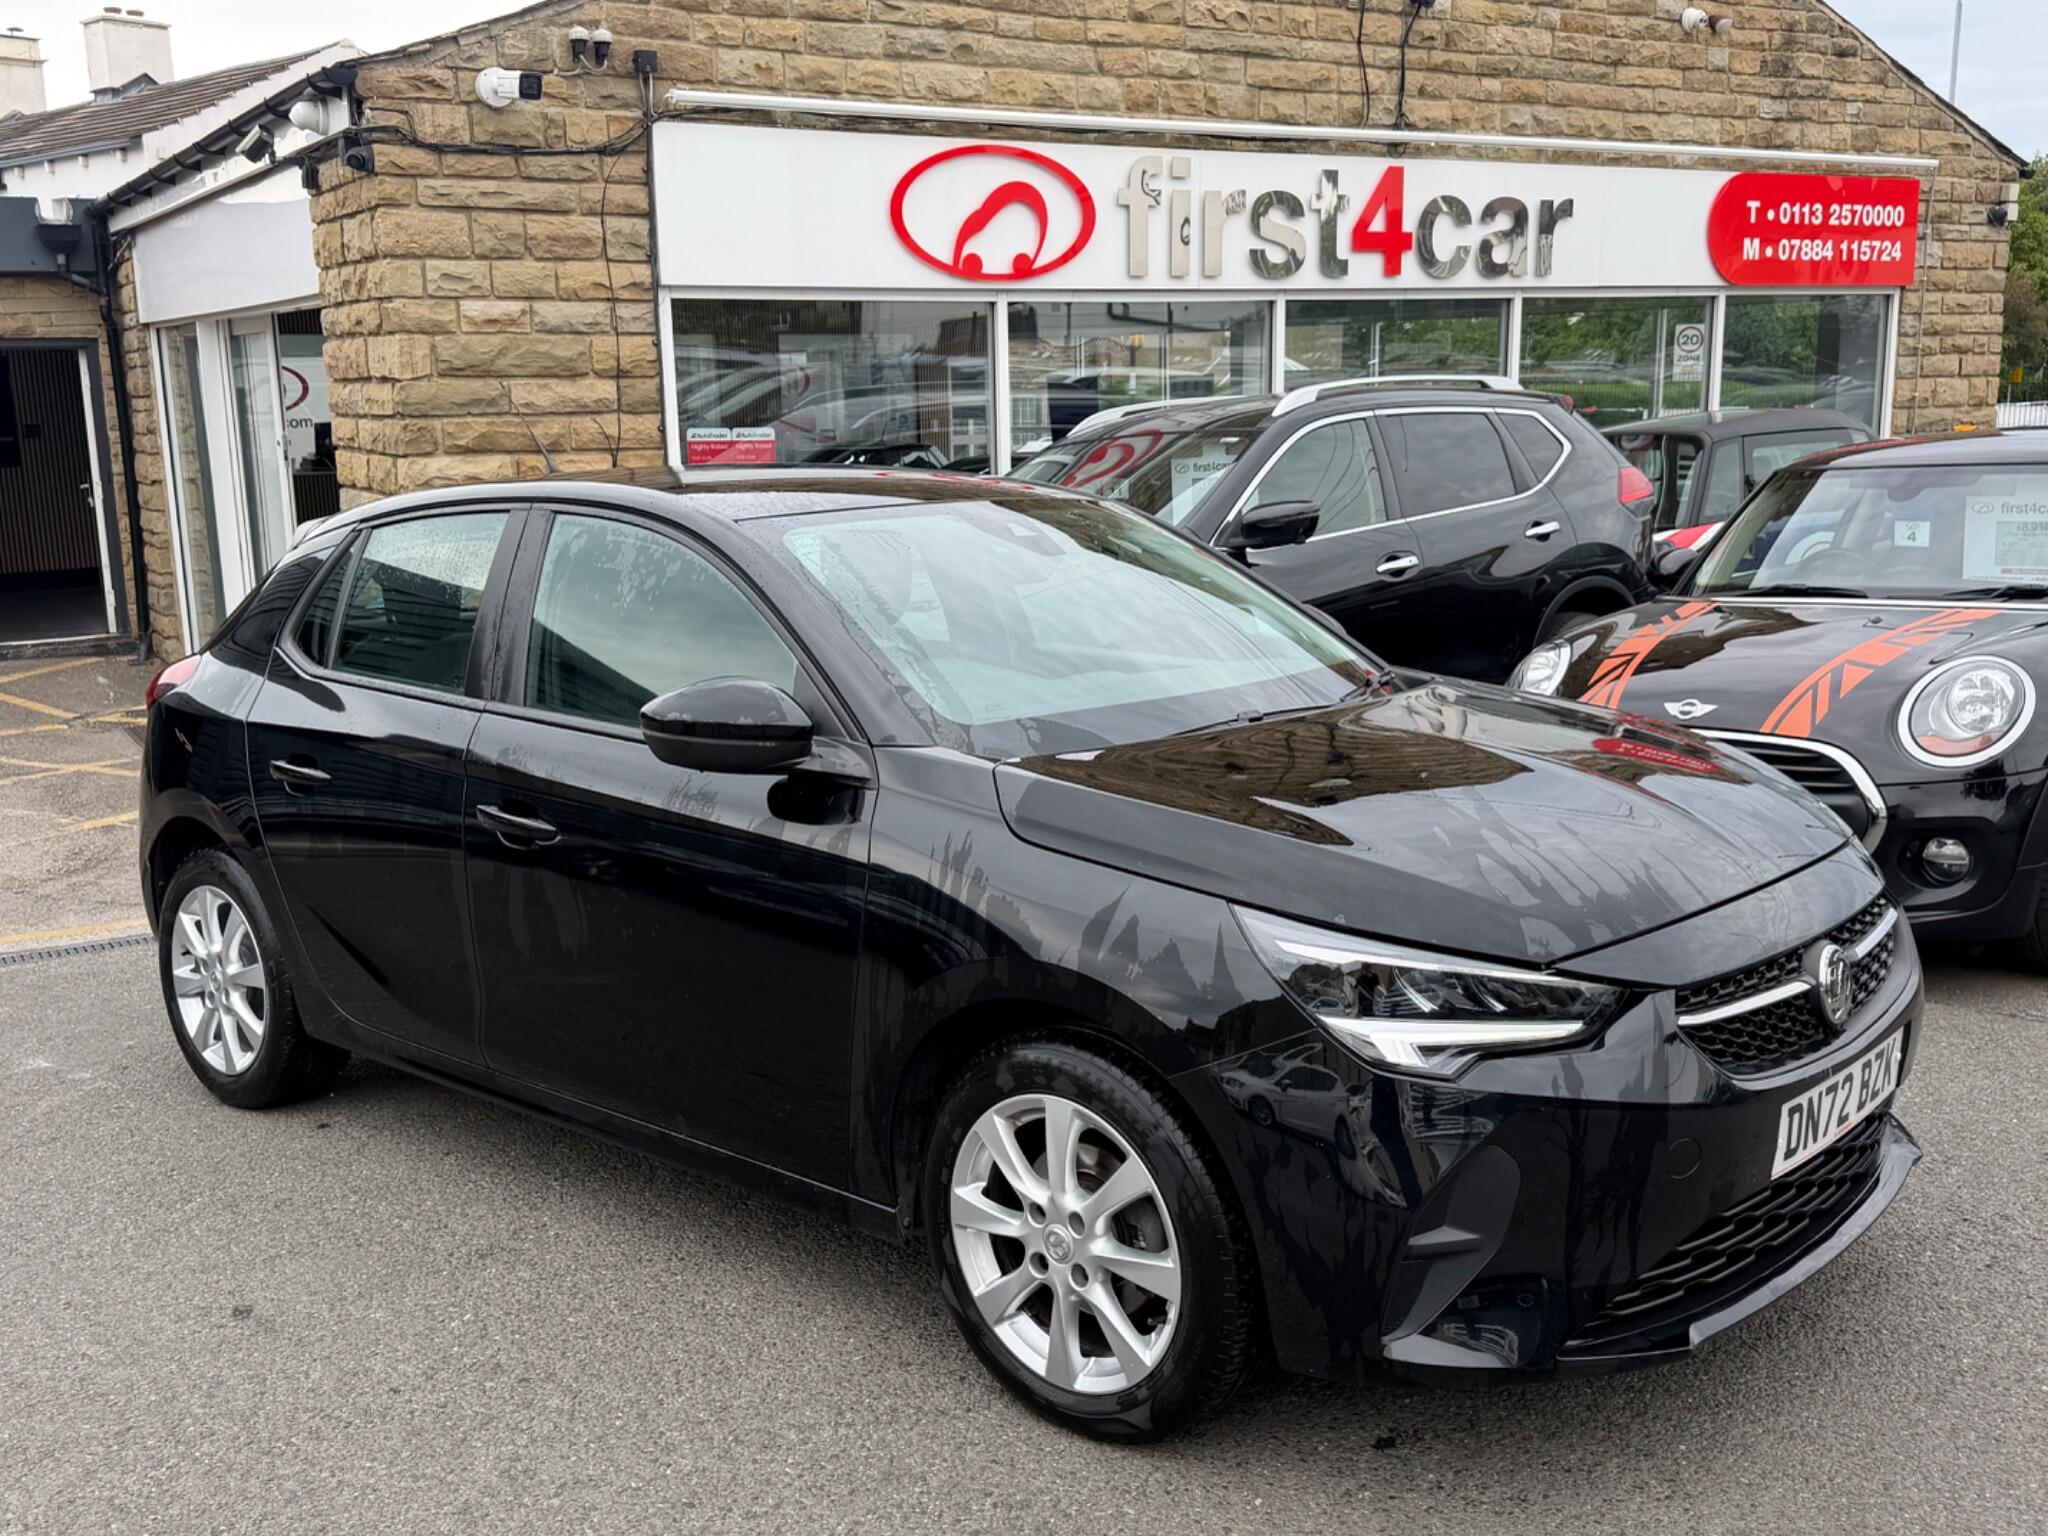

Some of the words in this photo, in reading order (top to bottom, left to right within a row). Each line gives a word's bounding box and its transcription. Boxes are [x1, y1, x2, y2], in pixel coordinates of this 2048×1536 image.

[1117, 155, 1574, 279] first4car
[1746, 200, 1761, 224] T
[1779, 202, 1823, 225] 0113
[1828, 204, 1905, 227] 2570000
[1742, 237, 1760, 260] M
[1777, 238, 1833, 261] 07884
[1840, 239, 1902, 262] 115724
[1681, 333, 1699, 346] 20
[2001, 502, 2048, 515] first4c
[1784, 1072, 1854, 1162] DN72
[1857, 1037, 1897, 1114] BZK
